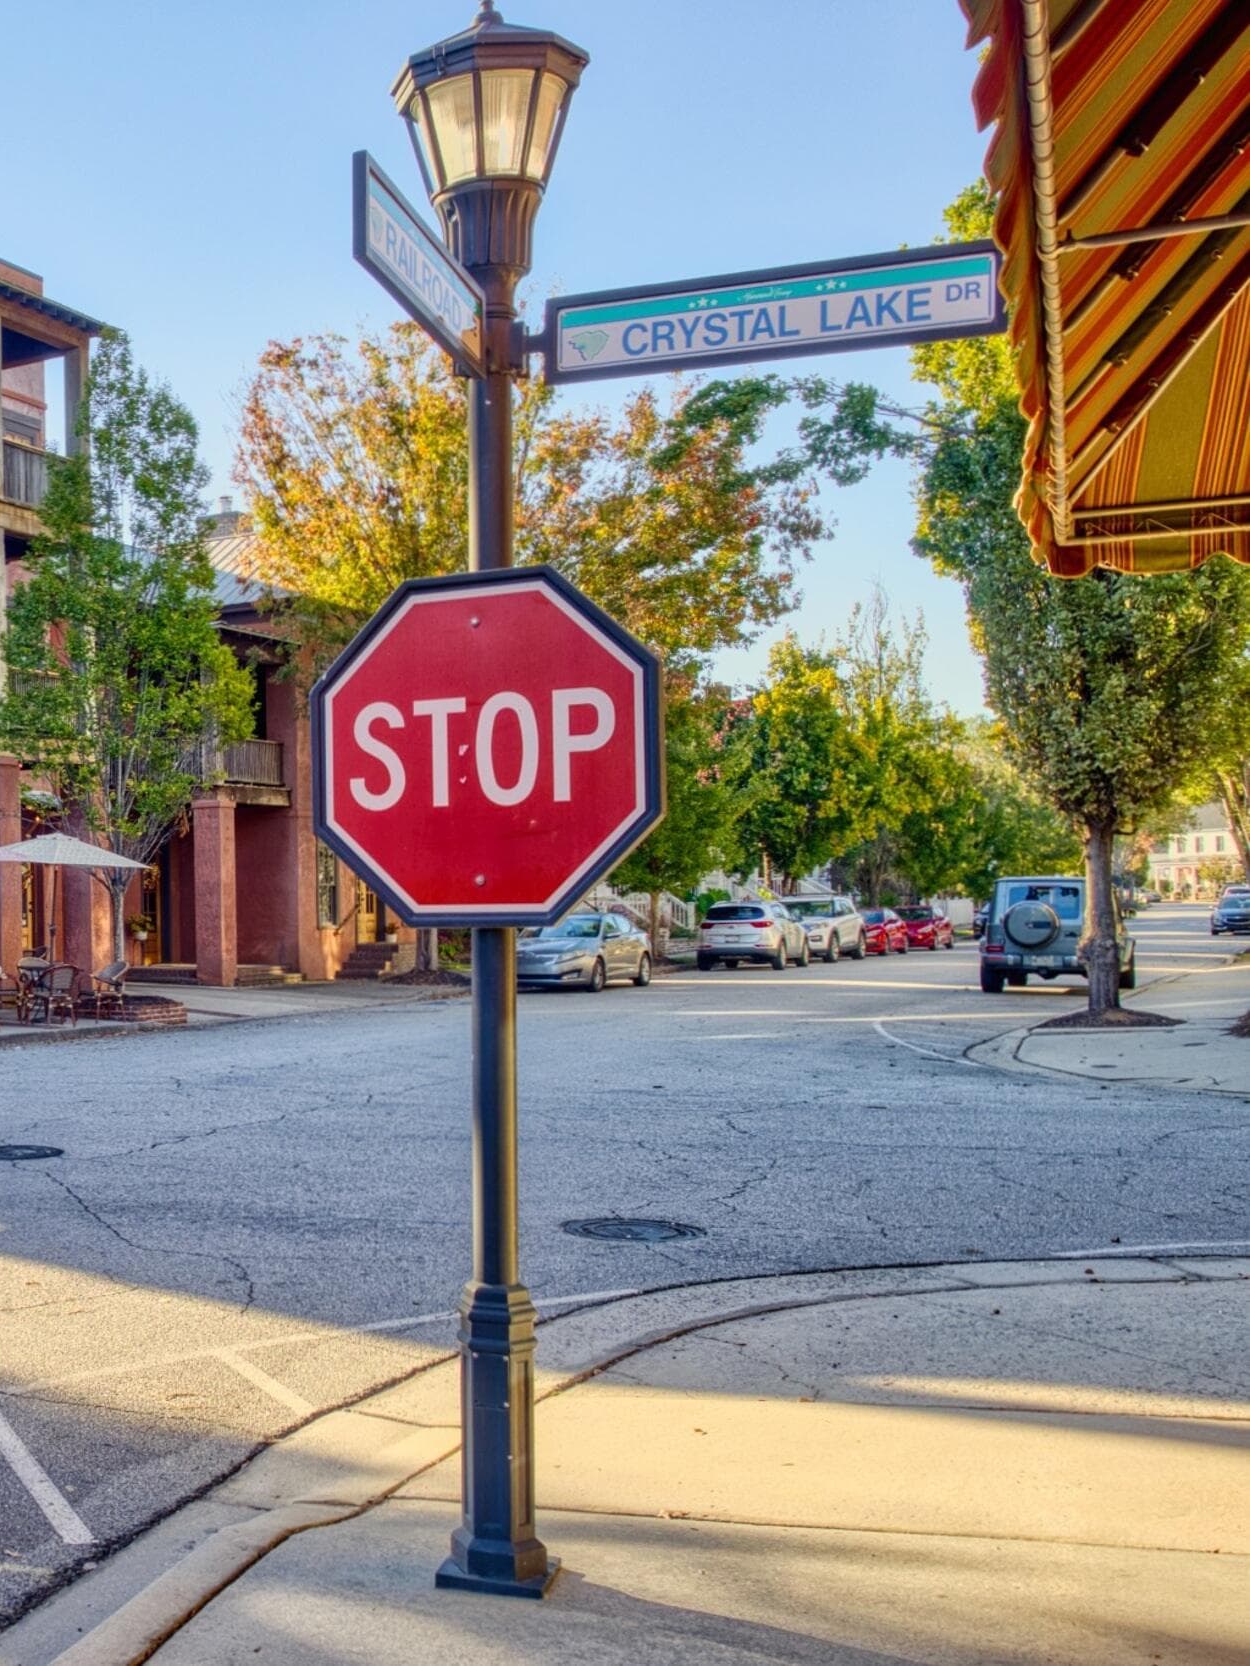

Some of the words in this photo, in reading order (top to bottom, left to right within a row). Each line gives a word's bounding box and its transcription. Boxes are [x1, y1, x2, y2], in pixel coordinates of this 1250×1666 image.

[386, 222, 462, 331] RAILROAD
[621, 305, 800, 356] CRYSTAL
[820, 287, 932, 333] LAKE
[946, 281, 981, 303] DR
[350, 686, 616, 811] STOP
